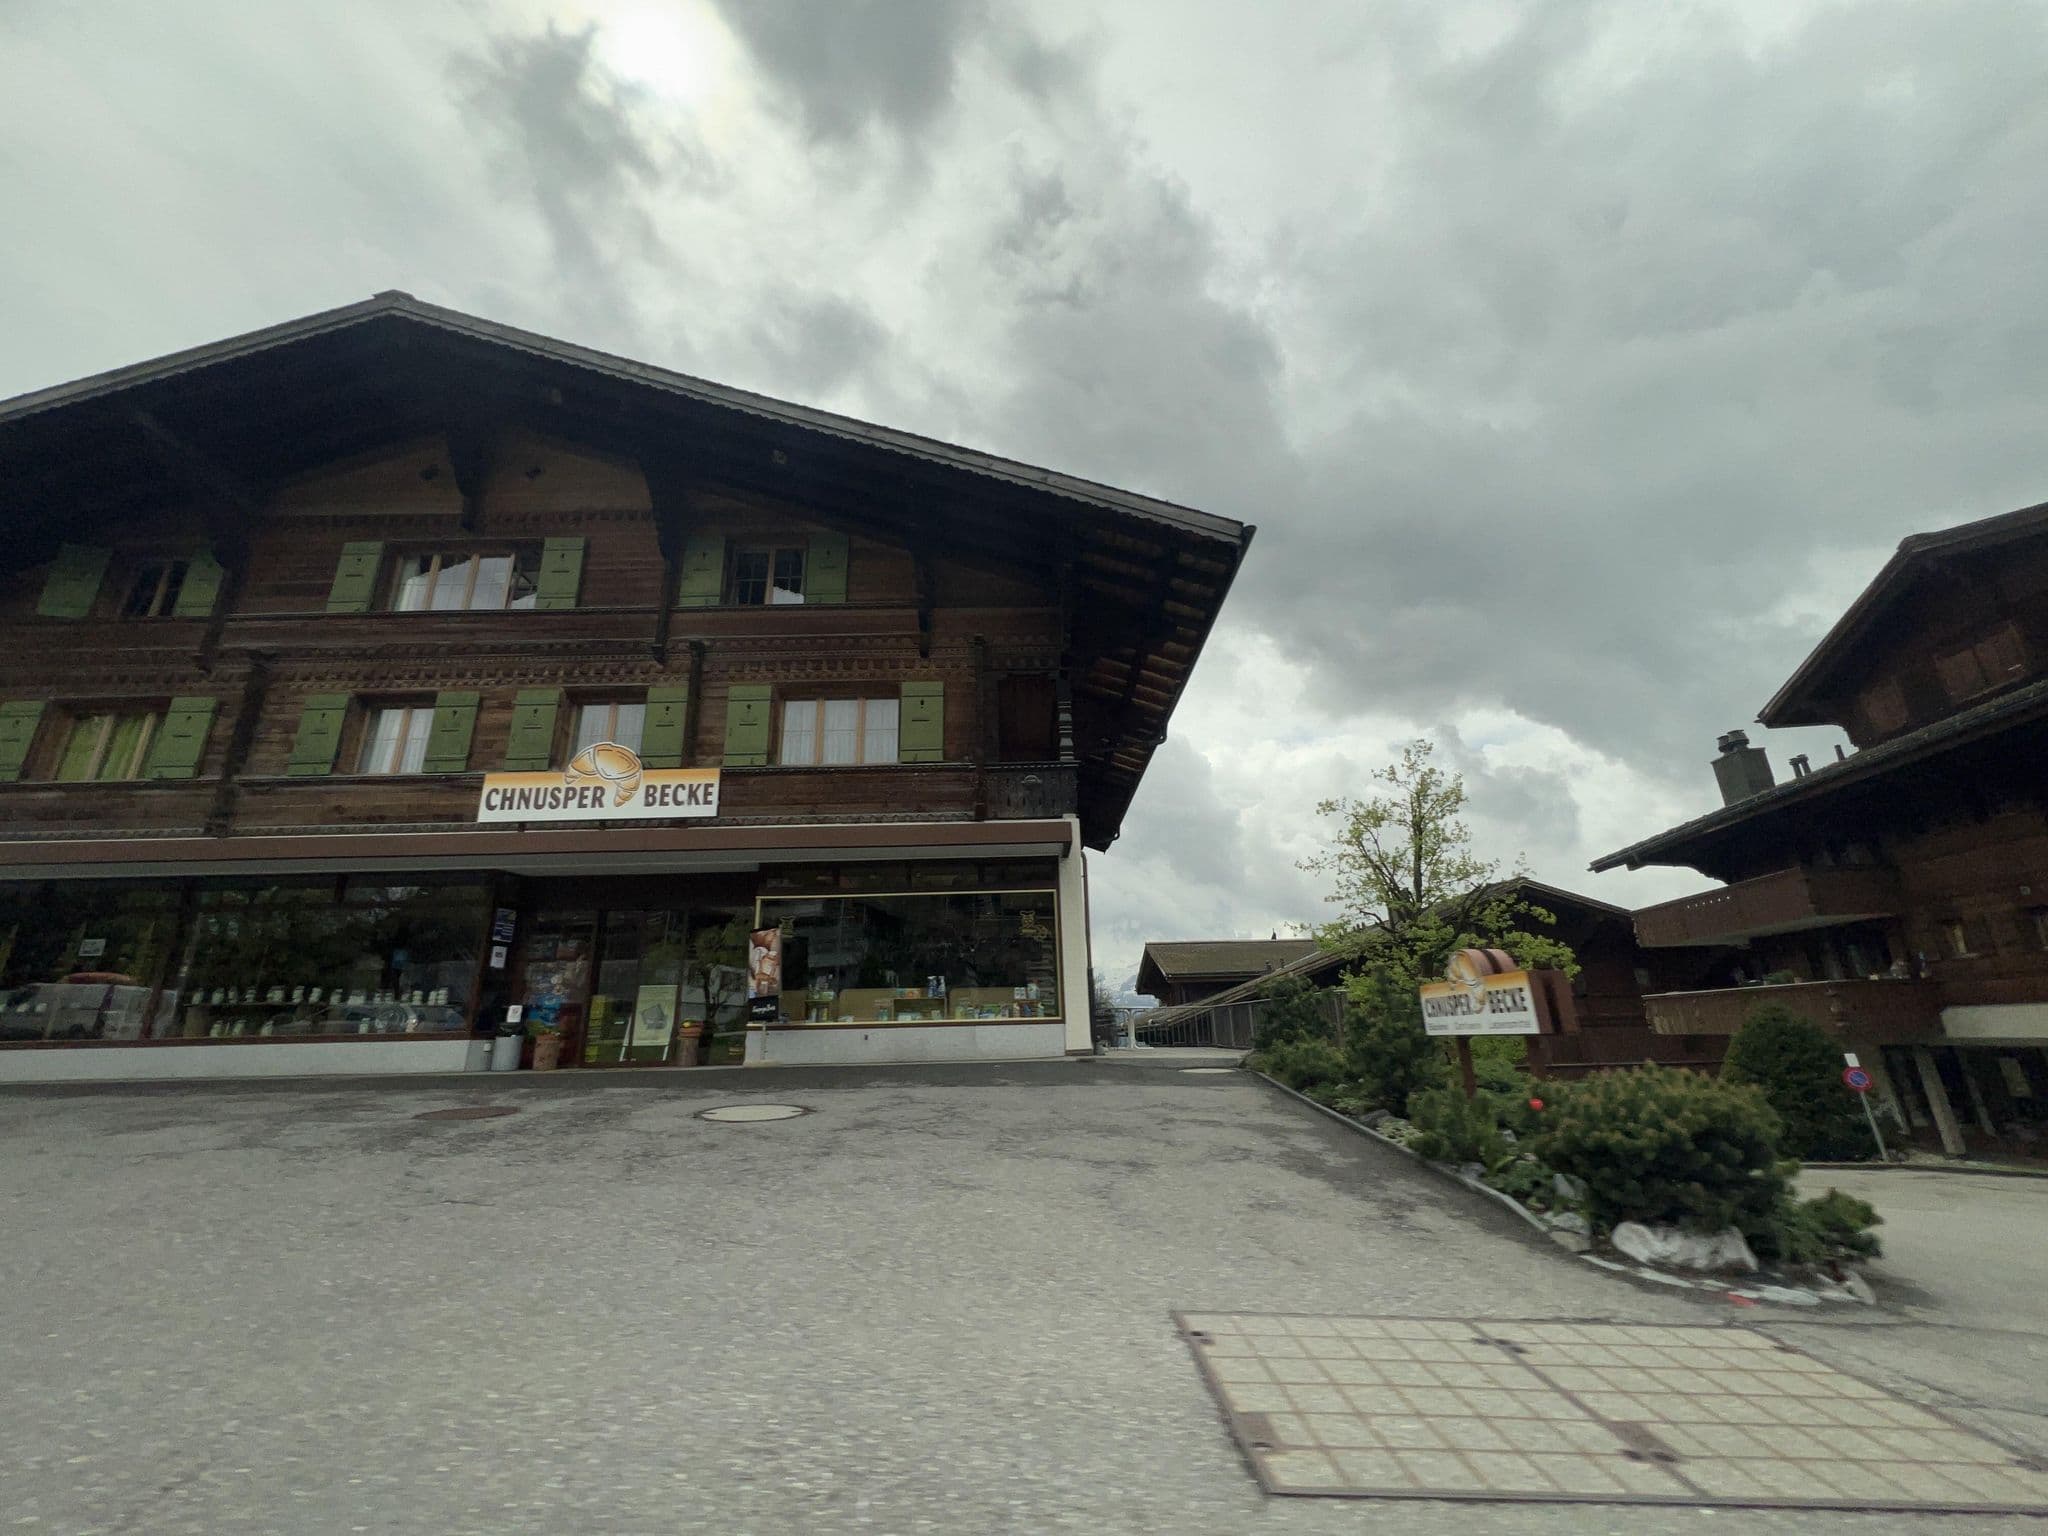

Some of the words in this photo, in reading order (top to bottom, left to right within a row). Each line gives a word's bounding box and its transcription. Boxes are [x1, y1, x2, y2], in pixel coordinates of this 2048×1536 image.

[485, 785, 606, 811] CHNUSPER
[643, 783, 715, 807] BECKE
[1487, 987, 1528, 1014] BECKE
